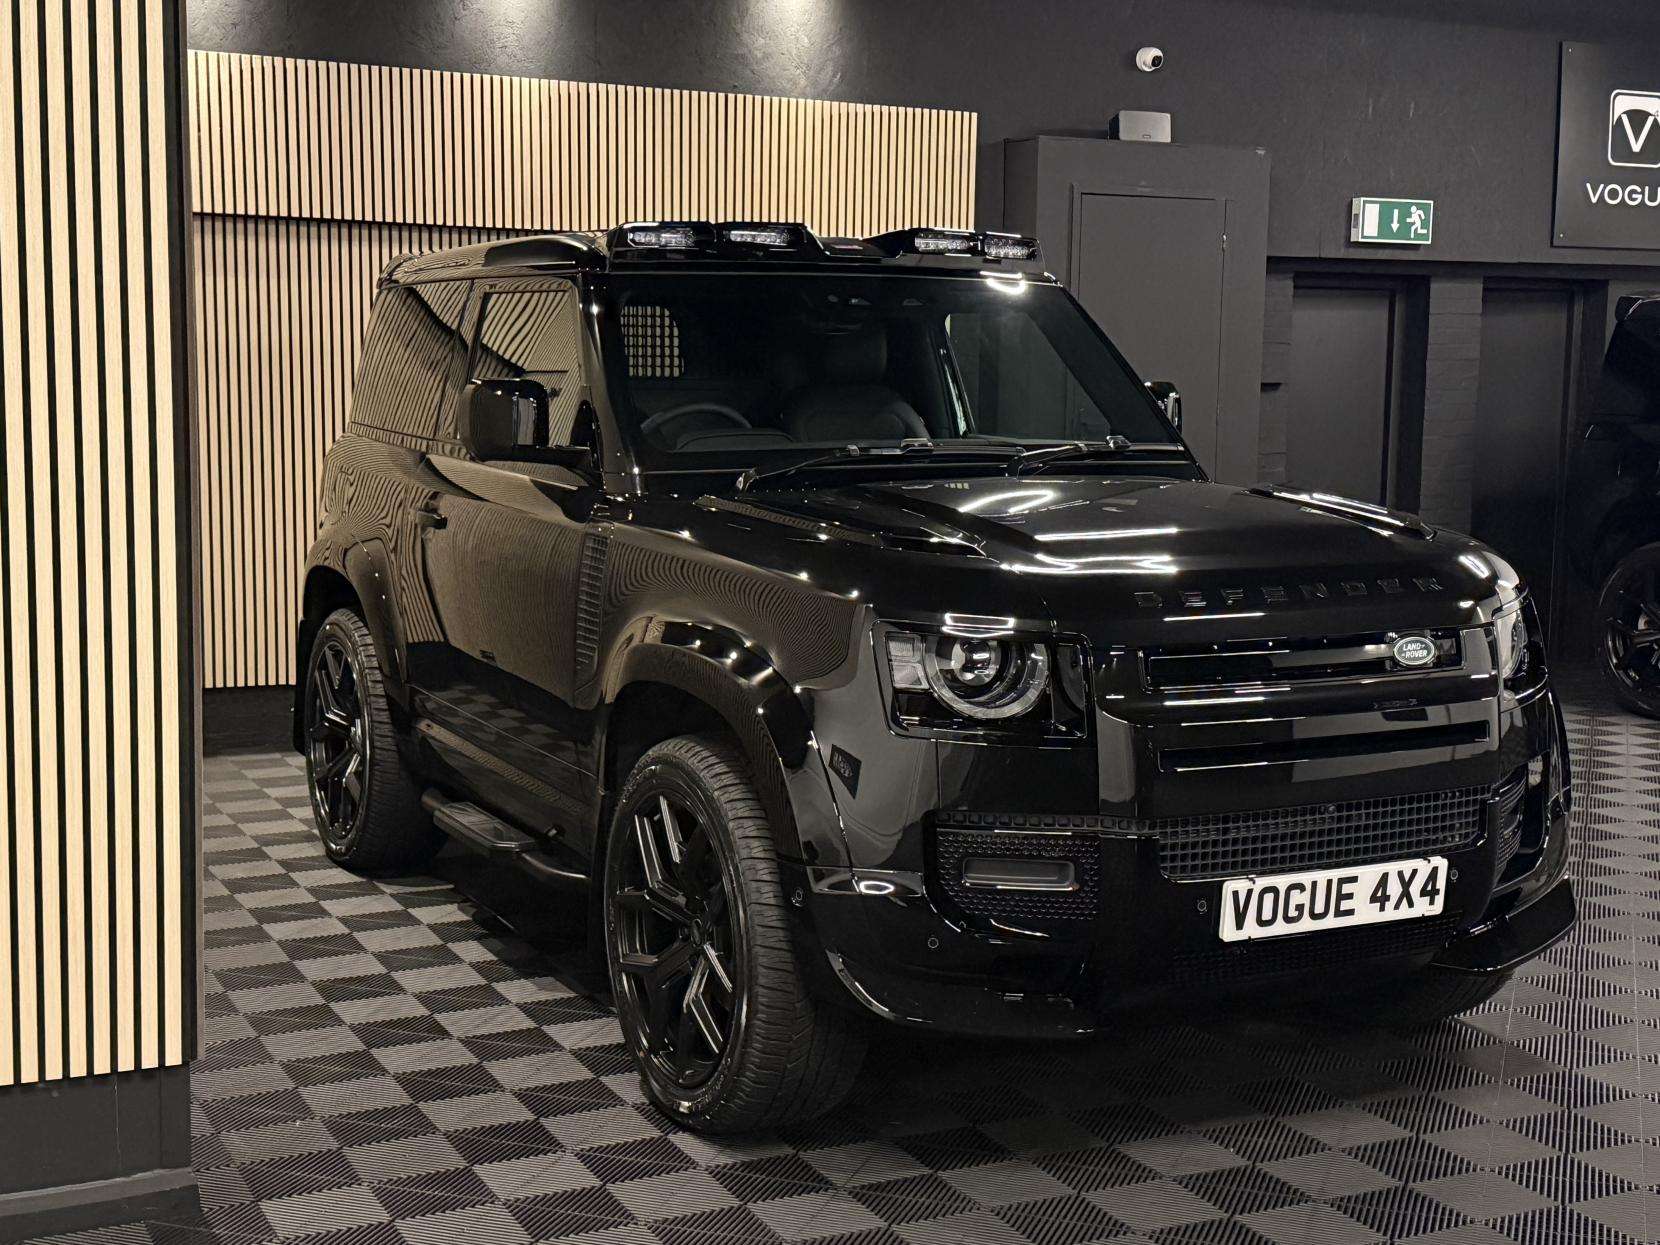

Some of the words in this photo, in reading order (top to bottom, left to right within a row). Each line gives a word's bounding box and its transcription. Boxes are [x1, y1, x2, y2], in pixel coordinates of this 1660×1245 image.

[1621, 113, 1655, 153] V
[1402, 642, 1421, 651] LAND
[1405, 650, 1428, 659] ROVER
[1231, 875, 1359, 931] VOGUE
[1369, 865, 1441, 913] 4X4
